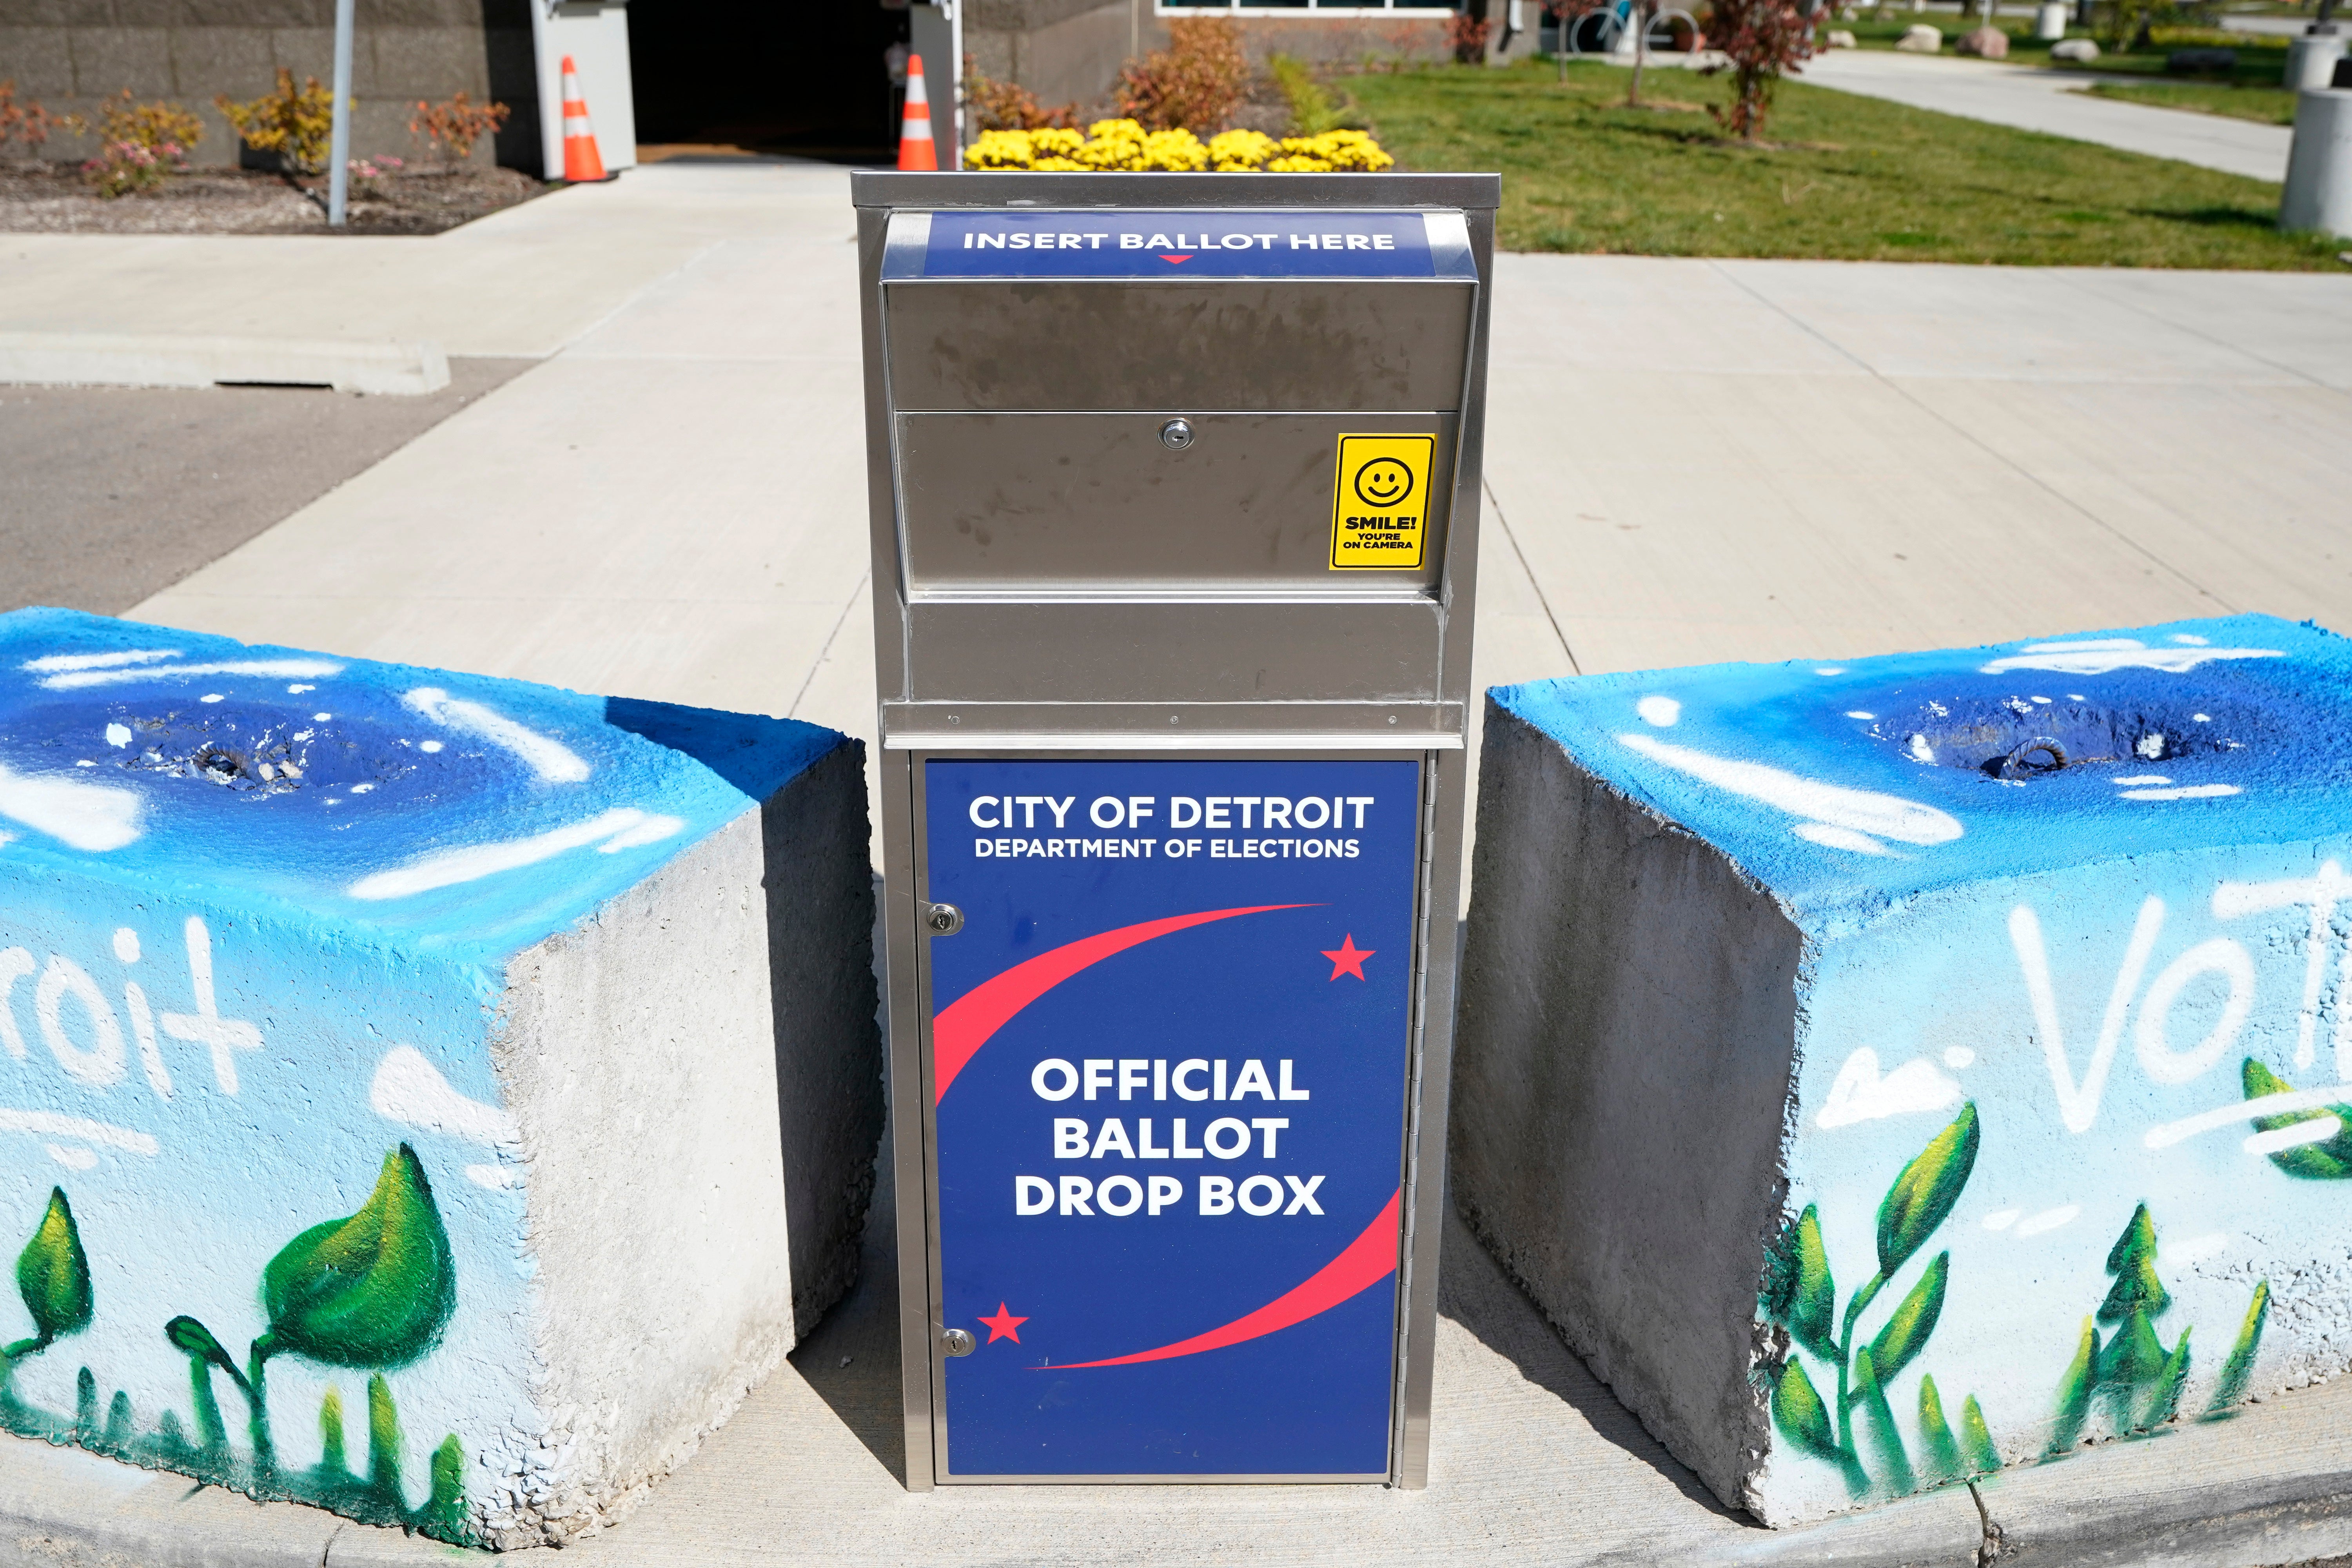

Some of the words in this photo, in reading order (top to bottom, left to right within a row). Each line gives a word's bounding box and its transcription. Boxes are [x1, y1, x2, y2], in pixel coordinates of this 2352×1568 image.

[965, 233, 1109, 249] INSERT
[1119, 233, 1278, 250] BALLOT
[1290, 233, 1395, 250] HERE
[1345, 517, 1417, 530] SMILE!
[969, 796, 1075, 828] CITY
[1090, 796, 1154, 828] OF
[1171, 796, 1374, 828] DETROIT
[976, 839, 1156, 857] DEPARTMENT
[1165, 839, 1202, 857] OF
[1211, 839, 1359, 858] ELECTIONS
[1031, 1058, 1309, 1101] OFFICIAL
[1054, 1118, 1289, 1159] BALLOT
[1016, 1175, 1182, 1216] DROP
[1200, 1175, 1325, 1216] BOX
